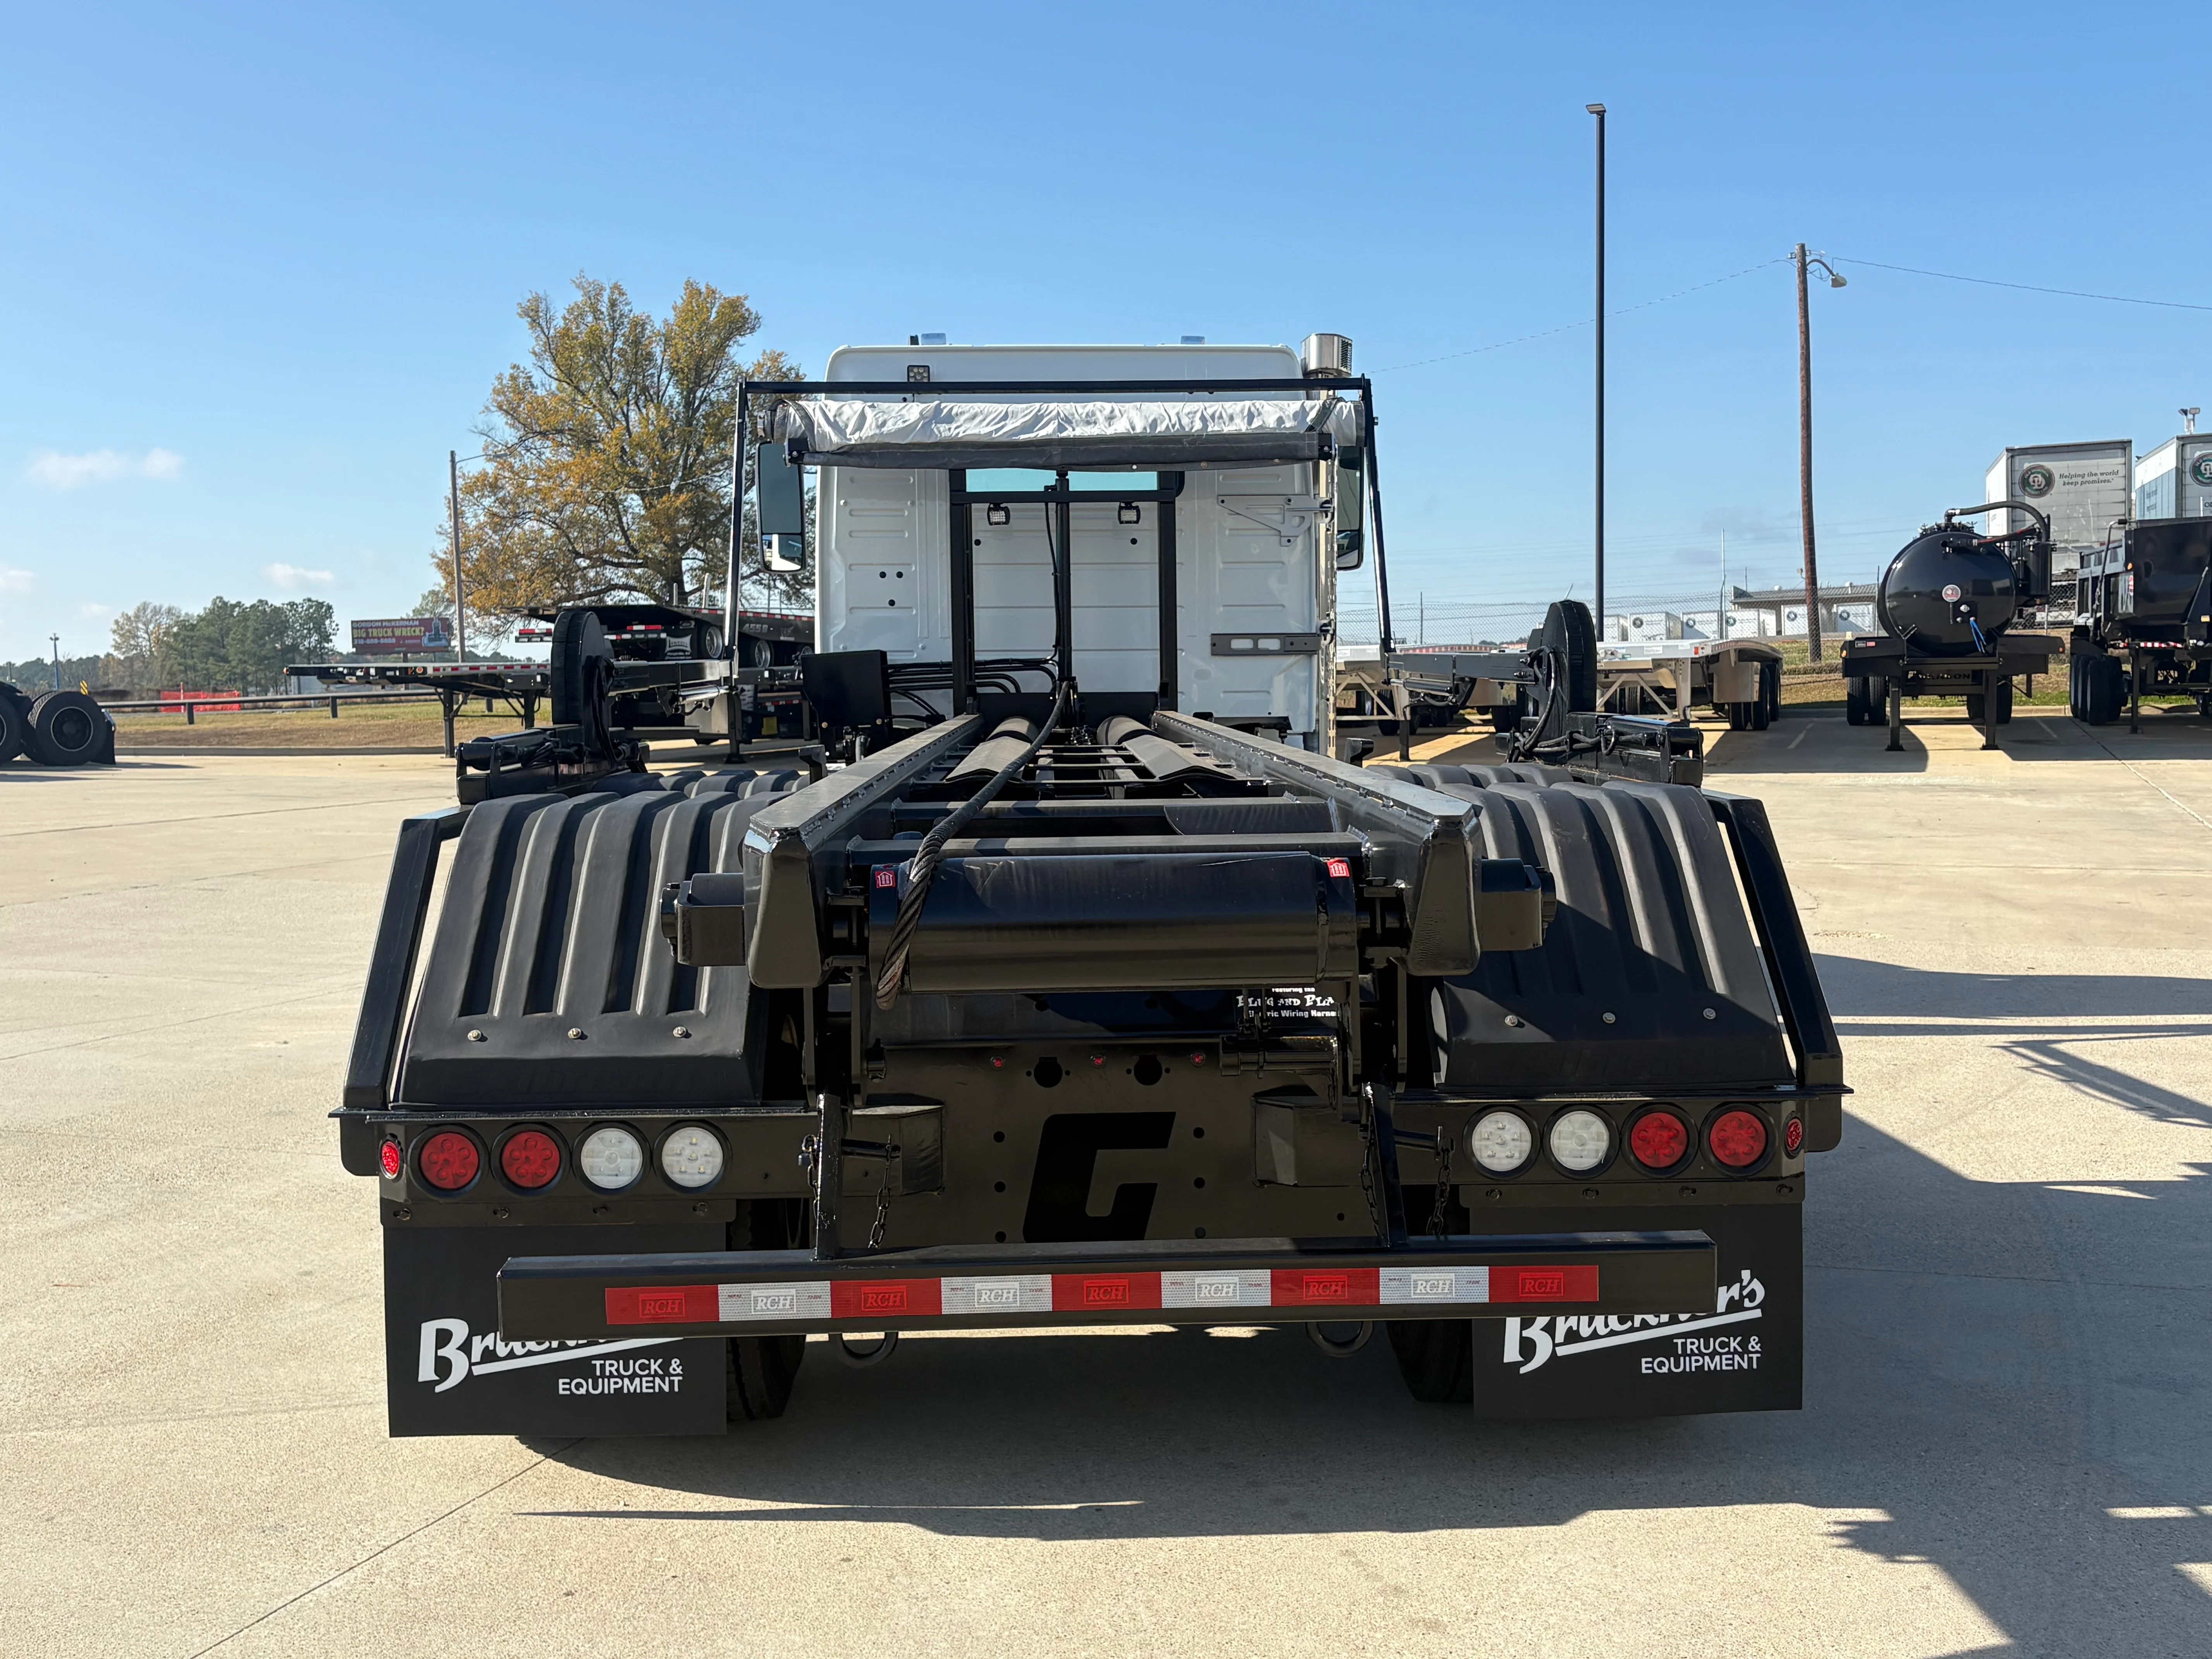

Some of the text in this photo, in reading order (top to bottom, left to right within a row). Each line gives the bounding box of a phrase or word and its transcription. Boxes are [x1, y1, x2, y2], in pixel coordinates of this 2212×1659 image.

[353, 627, 425, 638] BIG TRUCK WRECK?
[1304, 994, 1334, 1006] PLA
[1281, 1010, 1309, 1018] Wiring
[1089, 1286, 1125, 1300] RCH
[1200, 1284, 1235, 1297] RCH
[1308, 1281, 1344, 1295] RCH
[1416, 1279, 1451, 1294] RCH
[1524, 1279, 1560, 1293] RCH
[755, 1296, 792, 1310] RCH
[867, 1293, 903, 1307] RCH
[979, 1289, 1015, 1303] RCH
[644, 1300, 680, 1314] RCH
[1673, 1336, 1762, 1354] TRUCK &
[592, 1358, 684, 1376] TRUCK &
[1641, 1353, 1761, 1374] EQUIPMENT
[558, 1376, 683, 1395] EQUIPMENT
